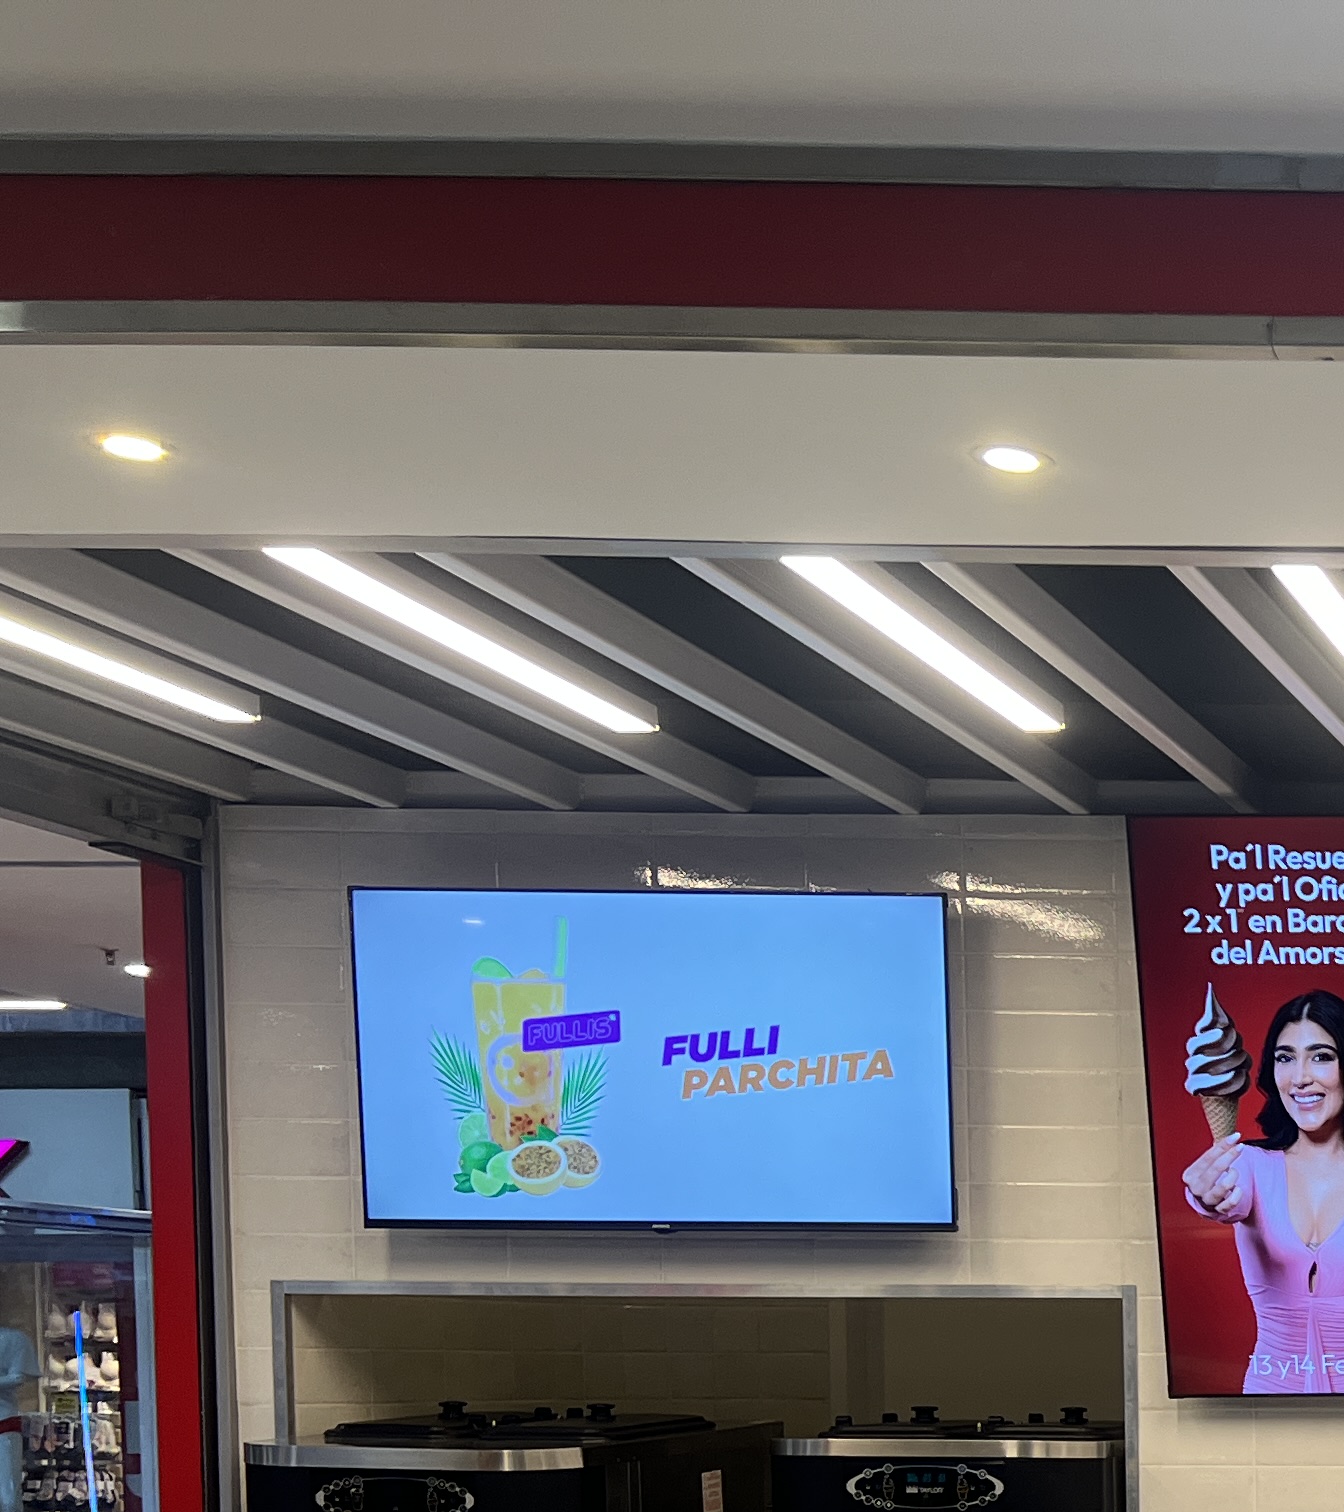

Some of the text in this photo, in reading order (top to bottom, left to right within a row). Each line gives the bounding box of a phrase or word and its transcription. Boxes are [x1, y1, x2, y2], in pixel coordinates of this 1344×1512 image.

[1216, 882, 1232, 907] y
[1183, 908, 1202, 933] 2
[1206, 914, 1222, 933] x
[1226, 908, 1240, 933] 1
[1248, 914, 1282, 933] en
[1211, 940, 1251, 965] del
[527, 1017, 612, 1046] FULLIS
[662, 1025, 781, 1067] FULLI
[681, 1050, 895, 1100] PARCHITA
